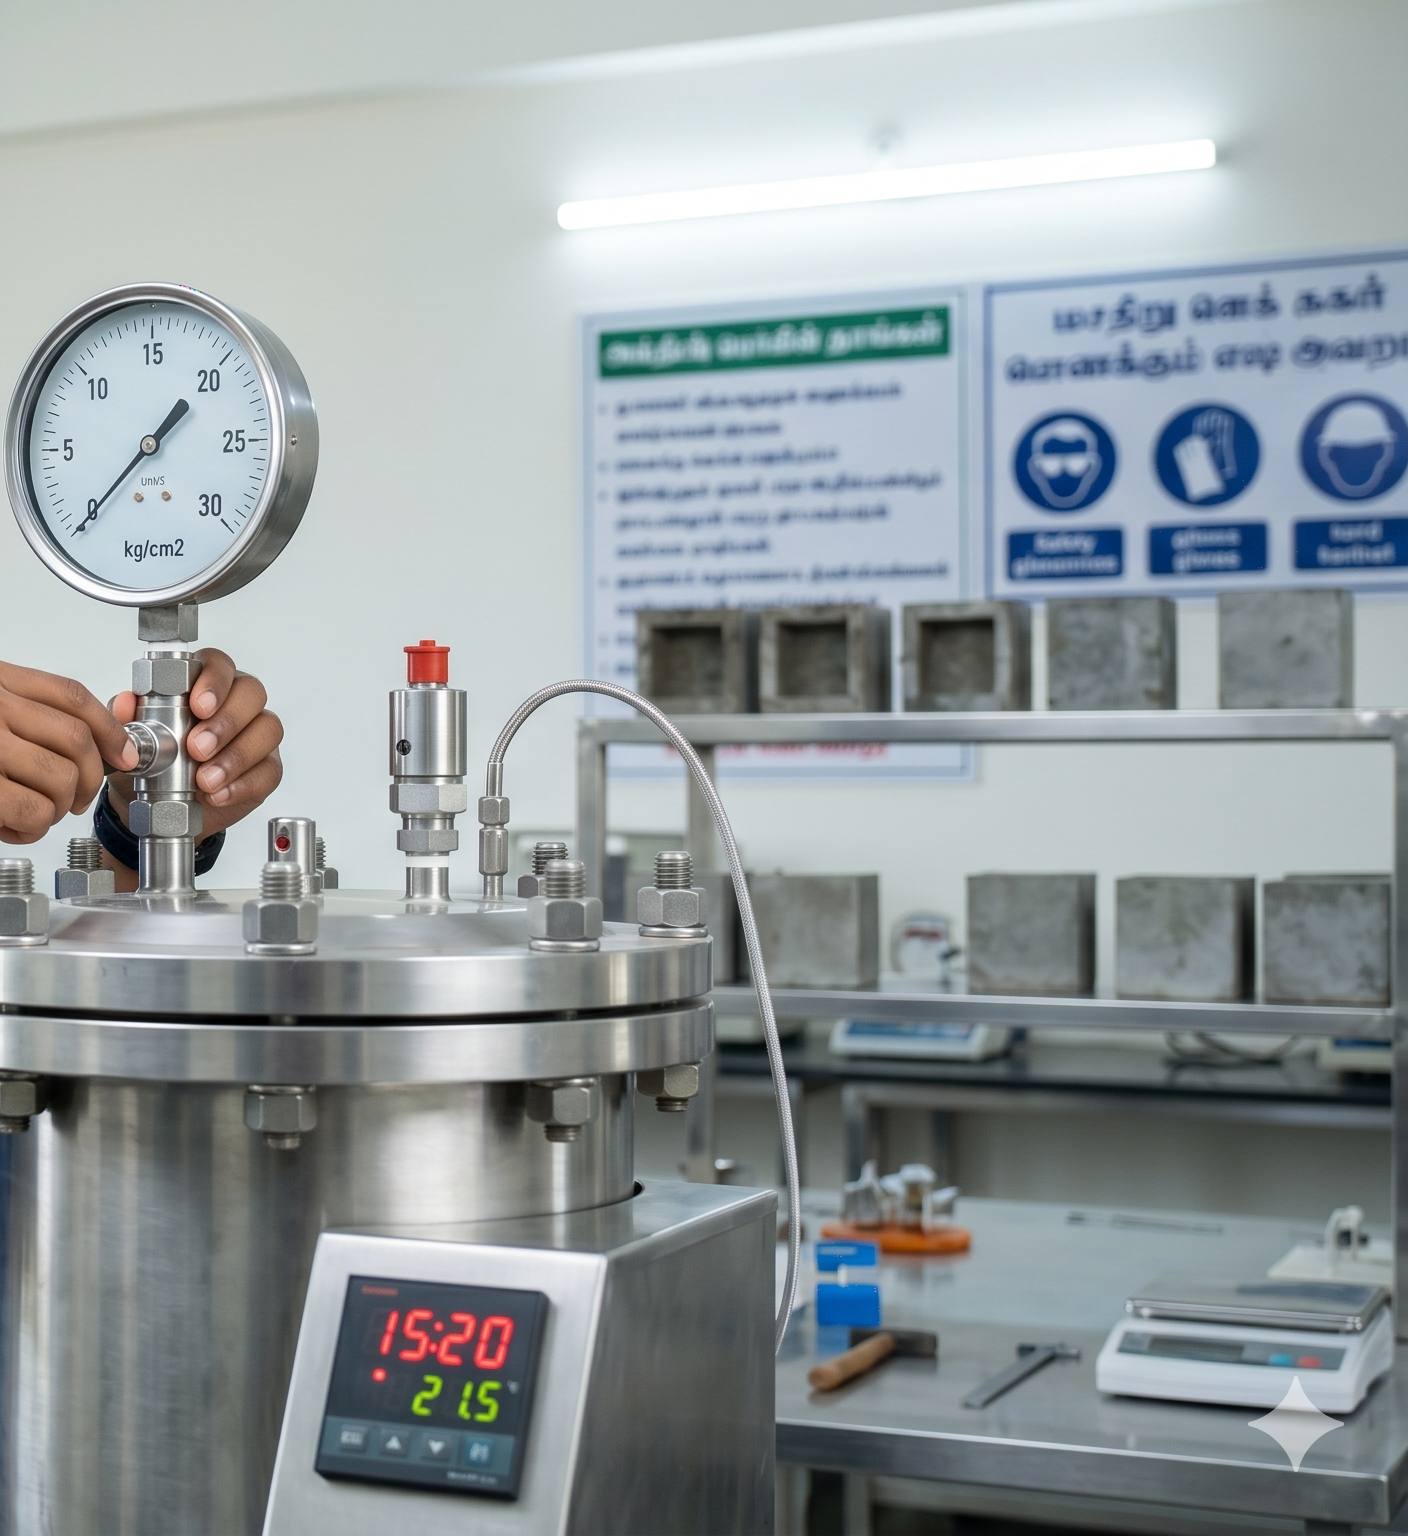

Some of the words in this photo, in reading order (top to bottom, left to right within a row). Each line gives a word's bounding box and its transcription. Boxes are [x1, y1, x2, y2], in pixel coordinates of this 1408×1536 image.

[143, 343, 163, 365] 15
[87, 377, 108, 400] 10
[197, 369, 220, 392] 20
[63, 439, 73, 461] 5
[222, 429, 245, 453] 25
[88, 498, 97, 520] 0
[198, 493, 221, 517] 30
[124, 538, 184, 562] kg/cm2
[380, 1309, 514, 1370] 15:20
